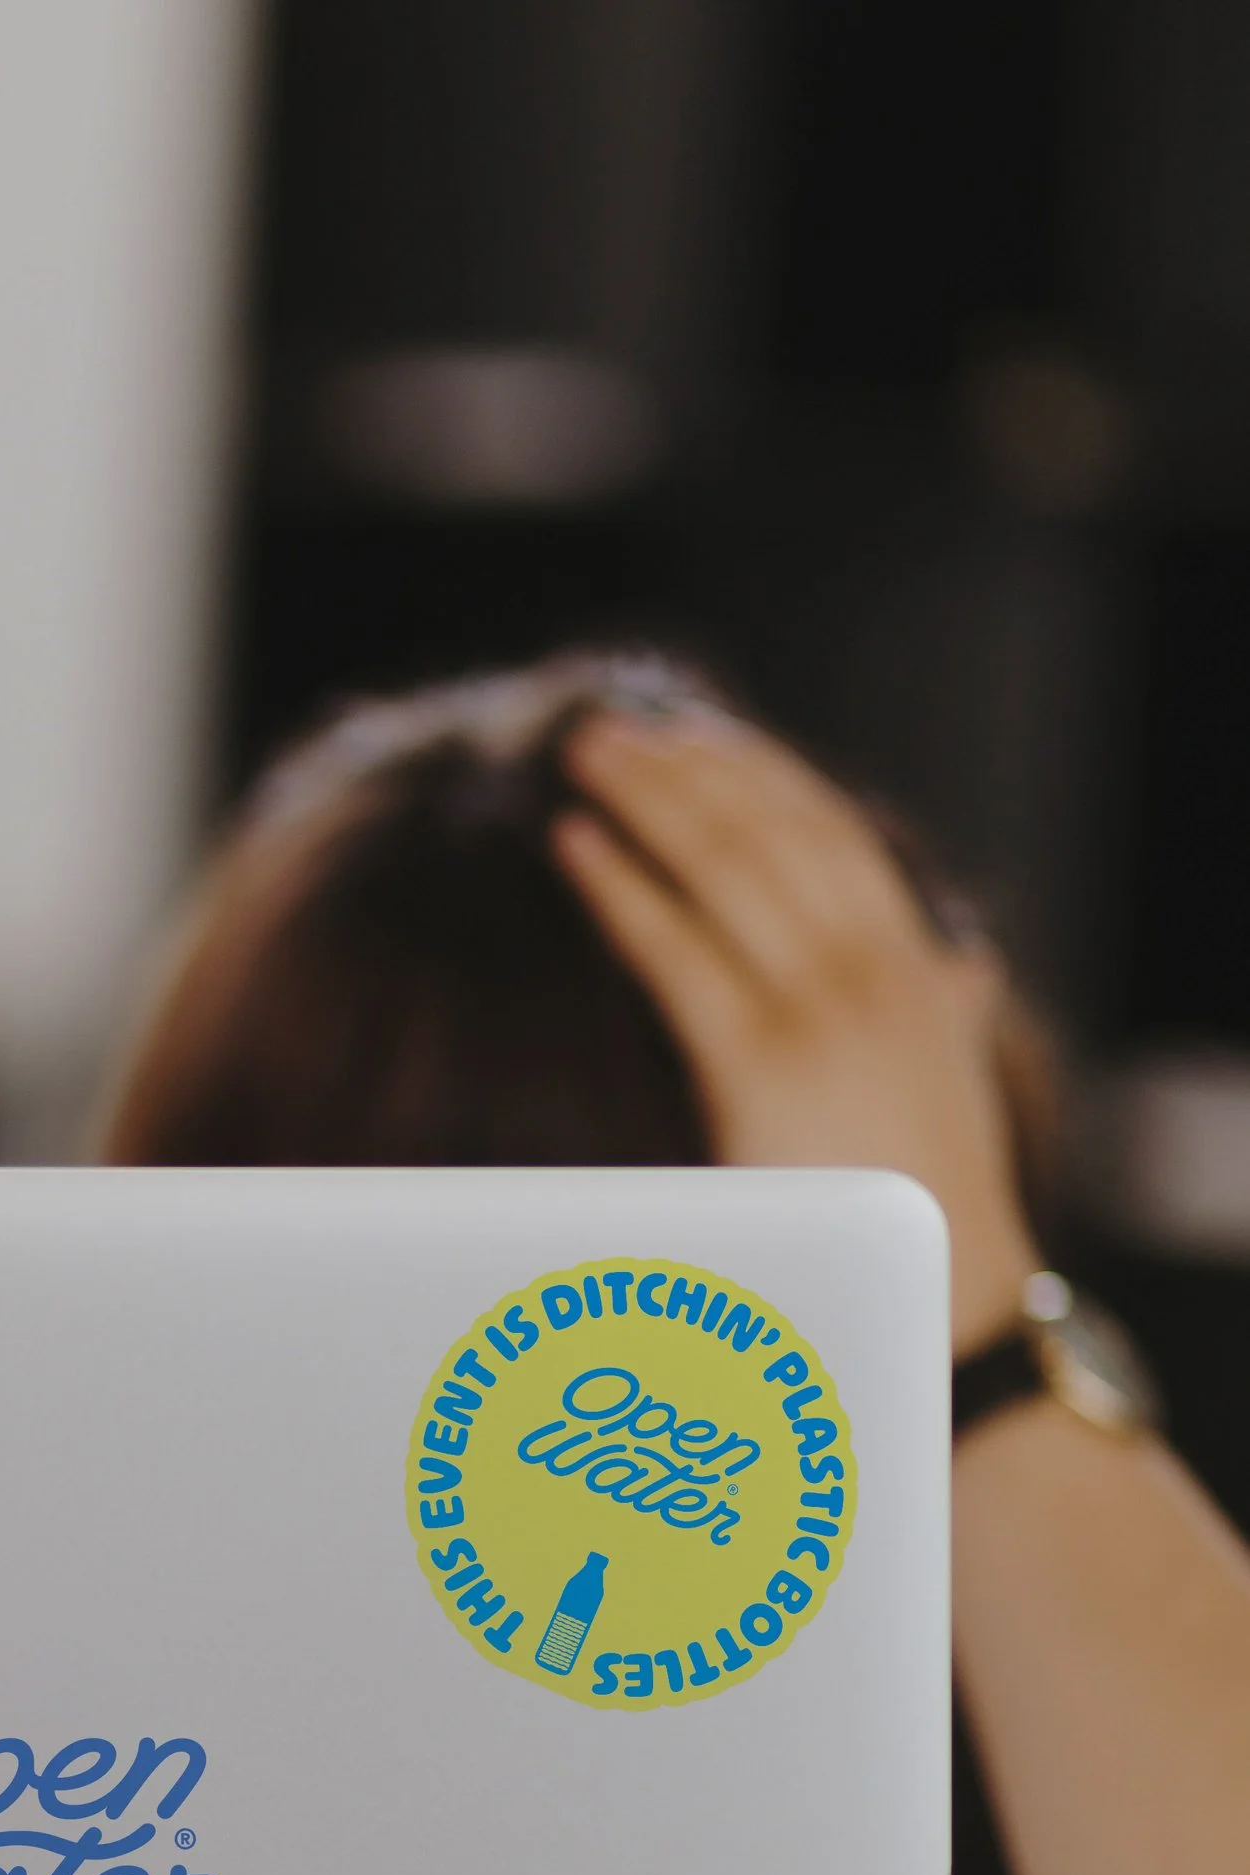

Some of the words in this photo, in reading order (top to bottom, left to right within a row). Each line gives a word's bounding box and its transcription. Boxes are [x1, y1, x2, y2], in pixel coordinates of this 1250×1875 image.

[485, 1305, 539, 1361] IS
[418, 1348, 497, 1529] EVENT
[562, 1367, 761, 1476] Open
[763, 1351, 844, 1571] PLASTIC
[431, 1538, 524, 1654] THIS
[592, 1570, 813, 1697] BOTTLES
